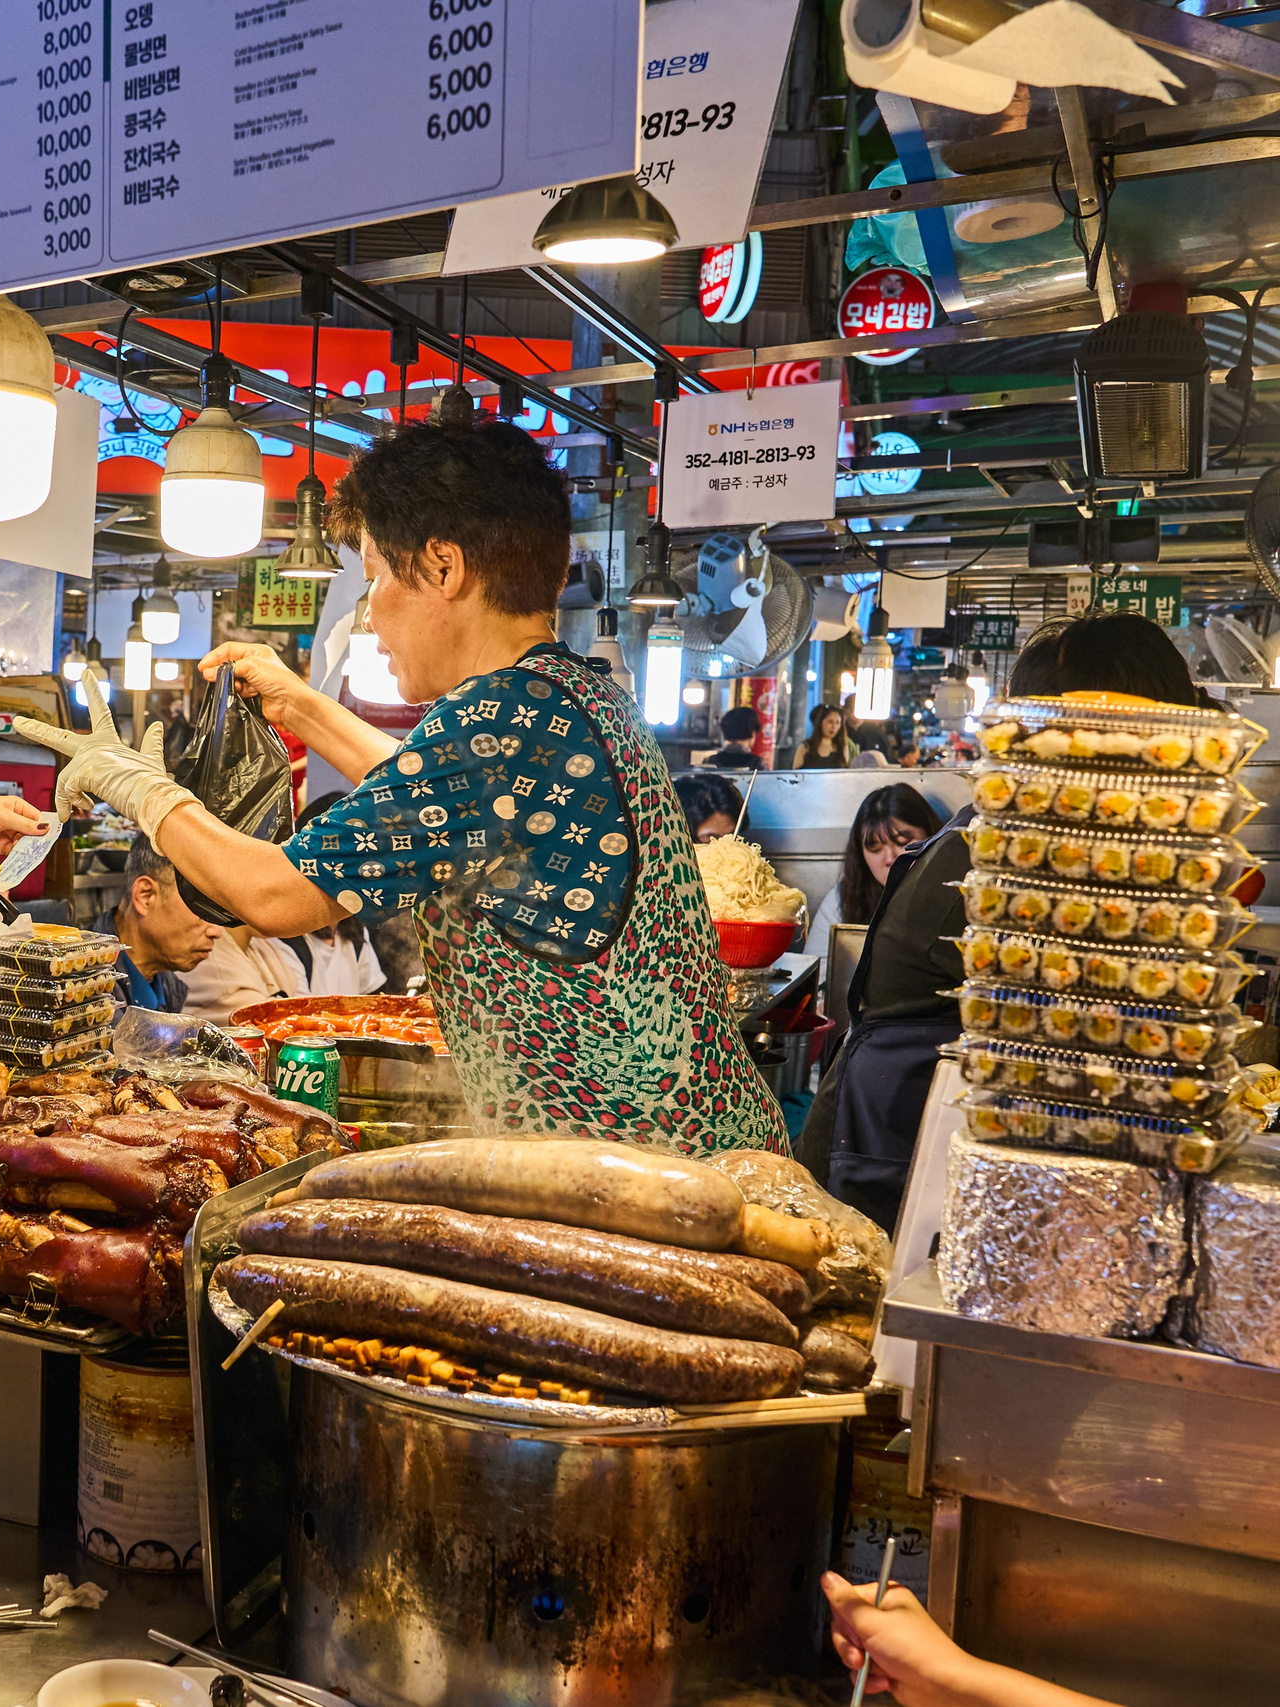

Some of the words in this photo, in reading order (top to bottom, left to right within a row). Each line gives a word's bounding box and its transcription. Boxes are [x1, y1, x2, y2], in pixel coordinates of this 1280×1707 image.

[124, 2, 153, 33] 오뎅
[43, 21, 92, 55] 8,000
[124, 33, 167, 68] 물냉면
[428, 21, 493, 62] 6,000
[36, 55, 92, 90] 10,000
[428, 62, 492, 101] 5,000
[643, 52, 709, 80] 협은행
[124, 66, 181, 101] 비빔냉면
[36, 90, 92, 125] 10,000
[124, 106, 167, 138] 콩국수
[426, 102, 491, 141] 6,000
[36, 124, 91, 157] 10,000
[123, 138, 181, 173] 잔치국수
[44, 158, 91, 190] 5,000
[123, 174, 180, 206] 비빔국수
[43, 193, 91, 225] 6,000
[43, 227, 91, 259] 3,000
[844, 301, 929, 330] 모녀김밥
[685, 445, 815, 469] 352-4181-2813-93
[709, 475, 743, 491] 예금주
[752, 473, 787, 489] 구성자
[1102, 580, 1147, 594] 성호네
[258, 592, 312, 617] 곱창볶음
[1071, 599, 1086, 609] 31
[276, 1060, 325, 1094] rite
